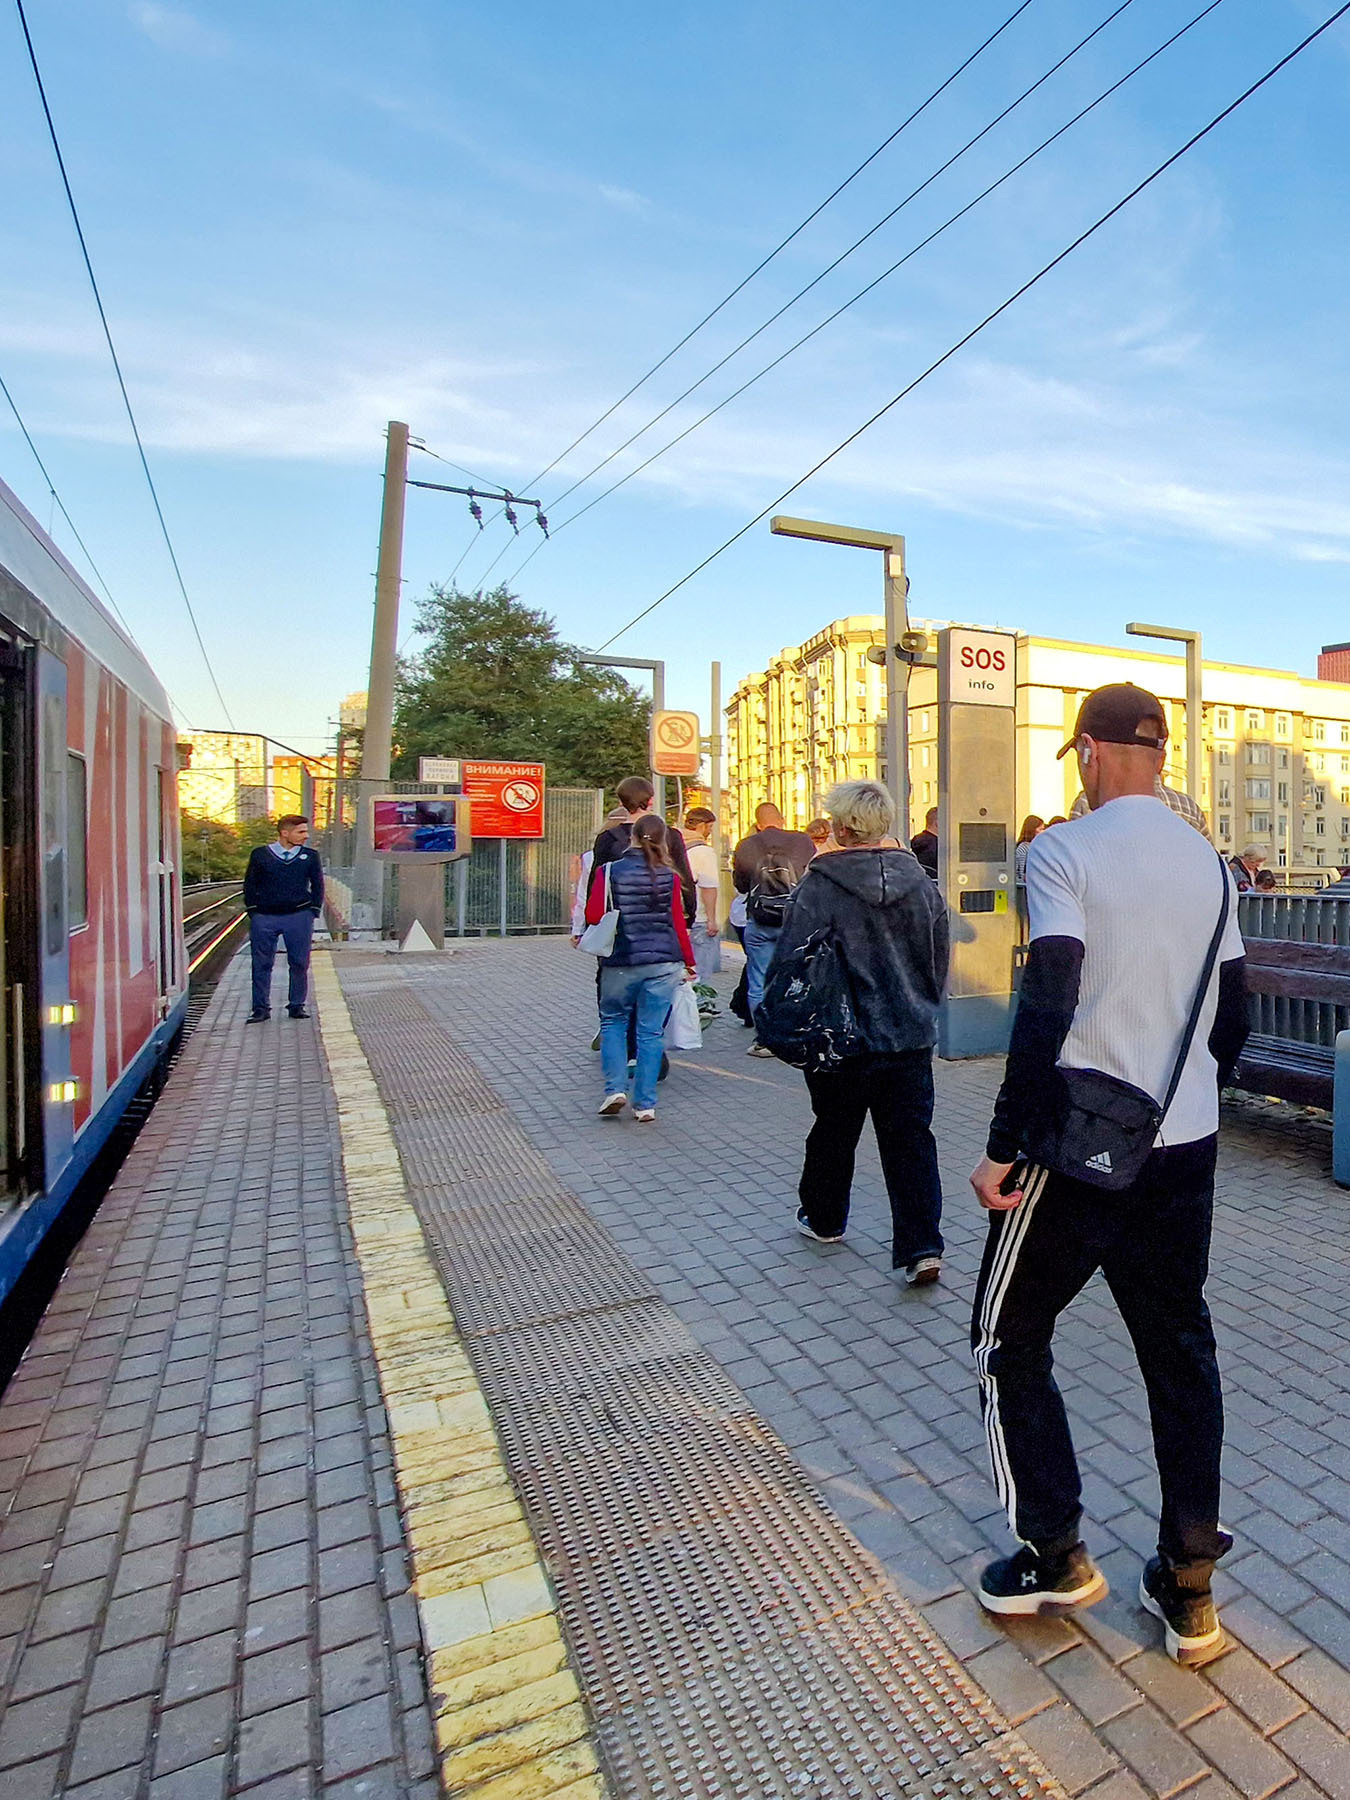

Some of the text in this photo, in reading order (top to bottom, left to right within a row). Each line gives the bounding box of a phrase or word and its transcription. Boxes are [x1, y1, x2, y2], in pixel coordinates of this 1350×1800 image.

[961, 646, 1005, 672] SOS
[968, 678, 995, 691] info
[465, 765, 541, 776] ВНИМАНИЕ!
[1085, 1160, 1113, 1174] adidas
